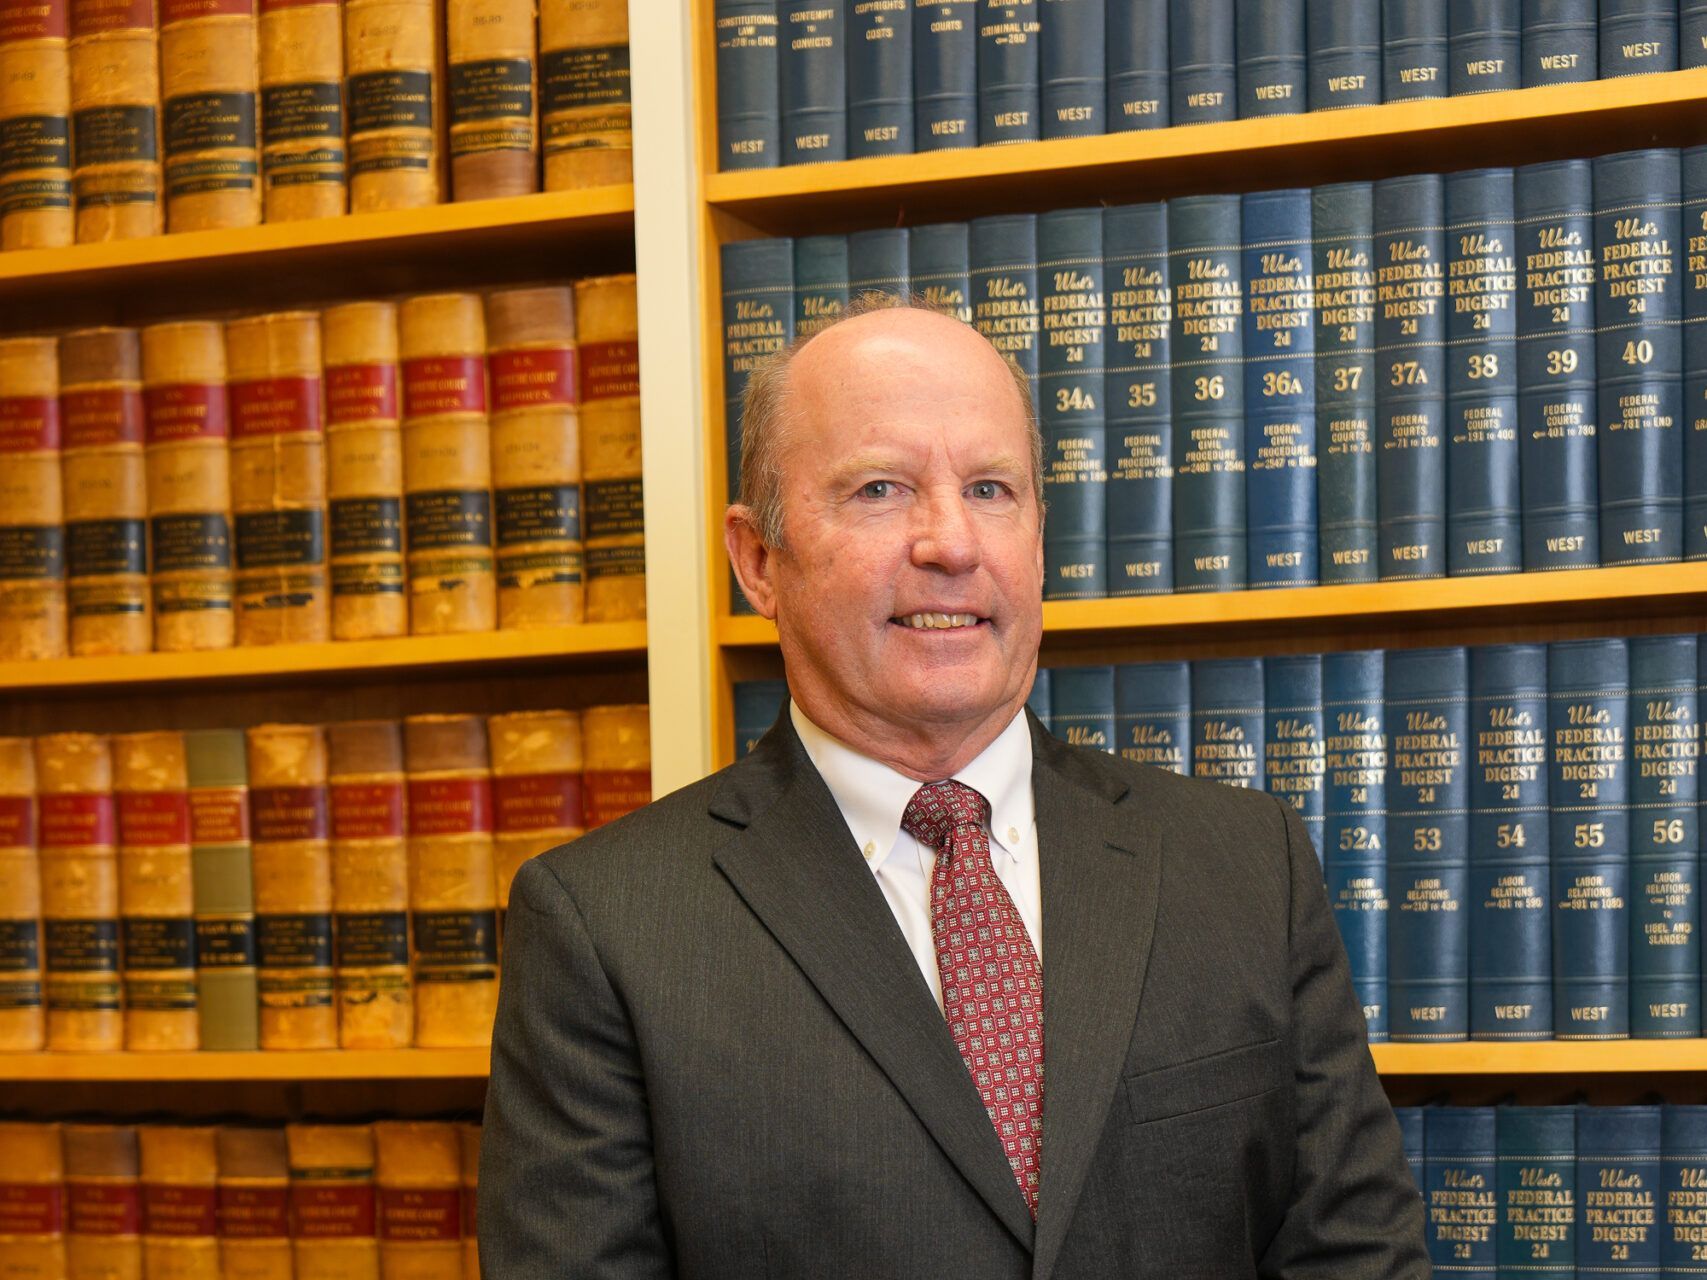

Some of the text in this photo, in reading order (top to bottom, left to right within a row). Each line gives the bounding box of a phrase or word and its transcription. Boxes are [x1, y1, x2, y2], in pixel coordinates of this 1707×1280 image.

[790, 9, 834, 22] CONTEMPT
[855, 0, 906, 15] COPYRIGHTS
[718, 14, 778, 27] CONSTITUTIONAL
[931, 20, 962, 32] COURTS
[982, 22, 1041, 36] CRIMINAL LAW
[738, 27, 756, 36] LAW
[866, 28, 893, 40] COSTS
[792, 37, 832, 50] CONVICTS
[1623, 41, 1661, 58] WEST
[1466, 59, 1504, 76] WEST
[1329, 74, 1366, 92] WEST
[796, 134, 830, 149] WEST
[864, 127, 898, 141] WEST
[731, 140, 765, 154] WEST
[1615, 217, 1658, 239] West's
[1461, 234, 1503, 255] West's
[1539, 227, 1582, 248] West's
[1389, 240, 1430, 261] West's
[1603, 240, 1672, 261] FEDERAL
[1449, 255, 1516, 276] FEDERAL
[1527, 249, 1595, 270] FEDERAL
[1188, 258, 1229, 279] West's
[1379, 263, 1443, 282] FEDERAL
[1603, 259, 1672, 280] PRACTICE
[1054, 271, 1094, 292] West's
[1449, 274, 1516, 294] PRACTICE
[1527, 268, 1595, 289] PRACTICE
[1177, 281, 1242, 300] FEDERAL
[1378, 281, 1444, 301] PRACTICE
[1610, 277, 1665, 298] DIGEST
[1044, 293, 1106, 312] FEDERAL
[1455, 293, 1510, 312] DIGEST
[1534, 287, 1589, 307] DIGEST
[1629, 298, 1647, 313] 2d
[1177, 298, 1242, 318] PRACTICE
[1384, 299, 1438, 319] DIGEST
[1552, 307, 1570, 322] 2d
[1044, 310, 1106, 329] PRACTICE
[1183, 316, 1237, 335] DIGEST
[1401, 319, 1418, 334] 2d
[1473, 312, 1491, 329] 2d
[1050, 328, 1101, 347] DIGEST
[1201, 336, 1219, 352] 2d
[1066, 347, 1084, 362] 2d
[1622, 339, 1654, 365] 40
[1468, 354, 1499, 379] 38
[1547, 348, 1578, 374] 39
[1334, 367, 1362, 391] 37
[1391, 360, 1429, 386] 37A
[1194, 375, 1224, 401] 36
[1263, 371, 1304, 397] 36A
[1056, 386, 1095, 412] 34A
[1128, 382, 1157, 407] 35
[1619, 395, 1659, 407] FEDERAL
[1464, 408, 1503, 419] FEDERAL
[1623, 406, 1656, 418] COURTS
[1467, 419, 1500, 430] COURTS
[1623, 419, 1640, 429] 781
[1653, 416, 1672, 428] END
[1191, 428, 1229, 440] FEDERAL
[1468, 431, 1484, 441] 191
[1497, 429, 1515, 440] 400
[1198, 440, 1221, 449] CIVIL
[1547, 536, 1584, 552] WEST
[1623, 529, 1660, 545] WEST
[1467, 538, 1503, 554] WEST
[1194, 556, 1230, 570] WEST
[1489, 707, 1531, 727] West's
[1568, 705, 1610, 726] West's
[1647, 701, 1690, 721] West's
[1407, 711, 1447, 731] West's
[1395, 732, 1459, 750] FEDERAL
[1479, 728, 1545, 746] FEDERAL
[1556, 727, 1624, 745] FEDERAL
[1394, 751, 1460, 768] PRACTICE
[1478, 747, 1546, 764] PRACTICE
[1556, 745, 1624, 763] PRACTICE
[1400, 769, 1452, 786] DIGEST
[1484, 764, 1538, 782] DIGEST
[1562, 763, 1615, 781] DIGEST
[1641, 760, 1696, 778] DIGEST
[1418, 788, 1435, 803] 2d
[1502, 785, 1520, 800] 2d
[1580, 783, 1597, 799] 2d
[1659, 780, 1676, 796] 2d
[1414, 827, 1442, 852] 53
[1497, 823, 1526, 848] 54
[1575, 823, 1605, 848] 55
[1653, 819, 1684, 844] 56
[1576, 876, 1604, 887] LABOR
[1654, 873, 1680, 883] LABOR
[1568, 887, 1613, 898] RELATIONS
[1646, 883, 1691, 894] RELATIONS
[1645, 923, 1692, 934] LIBEL AND
[1649, 934, 1688, 945] SLANDER
[1572, 1006, 1609, 1021] WEST
[1650, 1003, 1688, 1017] WEST
[1520, 1168, 1562, 1188] West's
[1599, 1169, 1642, 1188] West's
[1508, 1190, 1574, 1206] FEDERAL
[1587, 1191, 1654, 1207] FEDERAL
[1508, 1208, 1575, 1224] PRACTICE
[1587, 1208, 1655, 1224] PRACTICE
[1514, 1226, 1567, 1240] DIGEST
[1592, 1227, 1647, 1242] DIGEST
[1531, 1243, 1549, 1258] 2d
[1611, 1245, 1629, 1260] 2d
